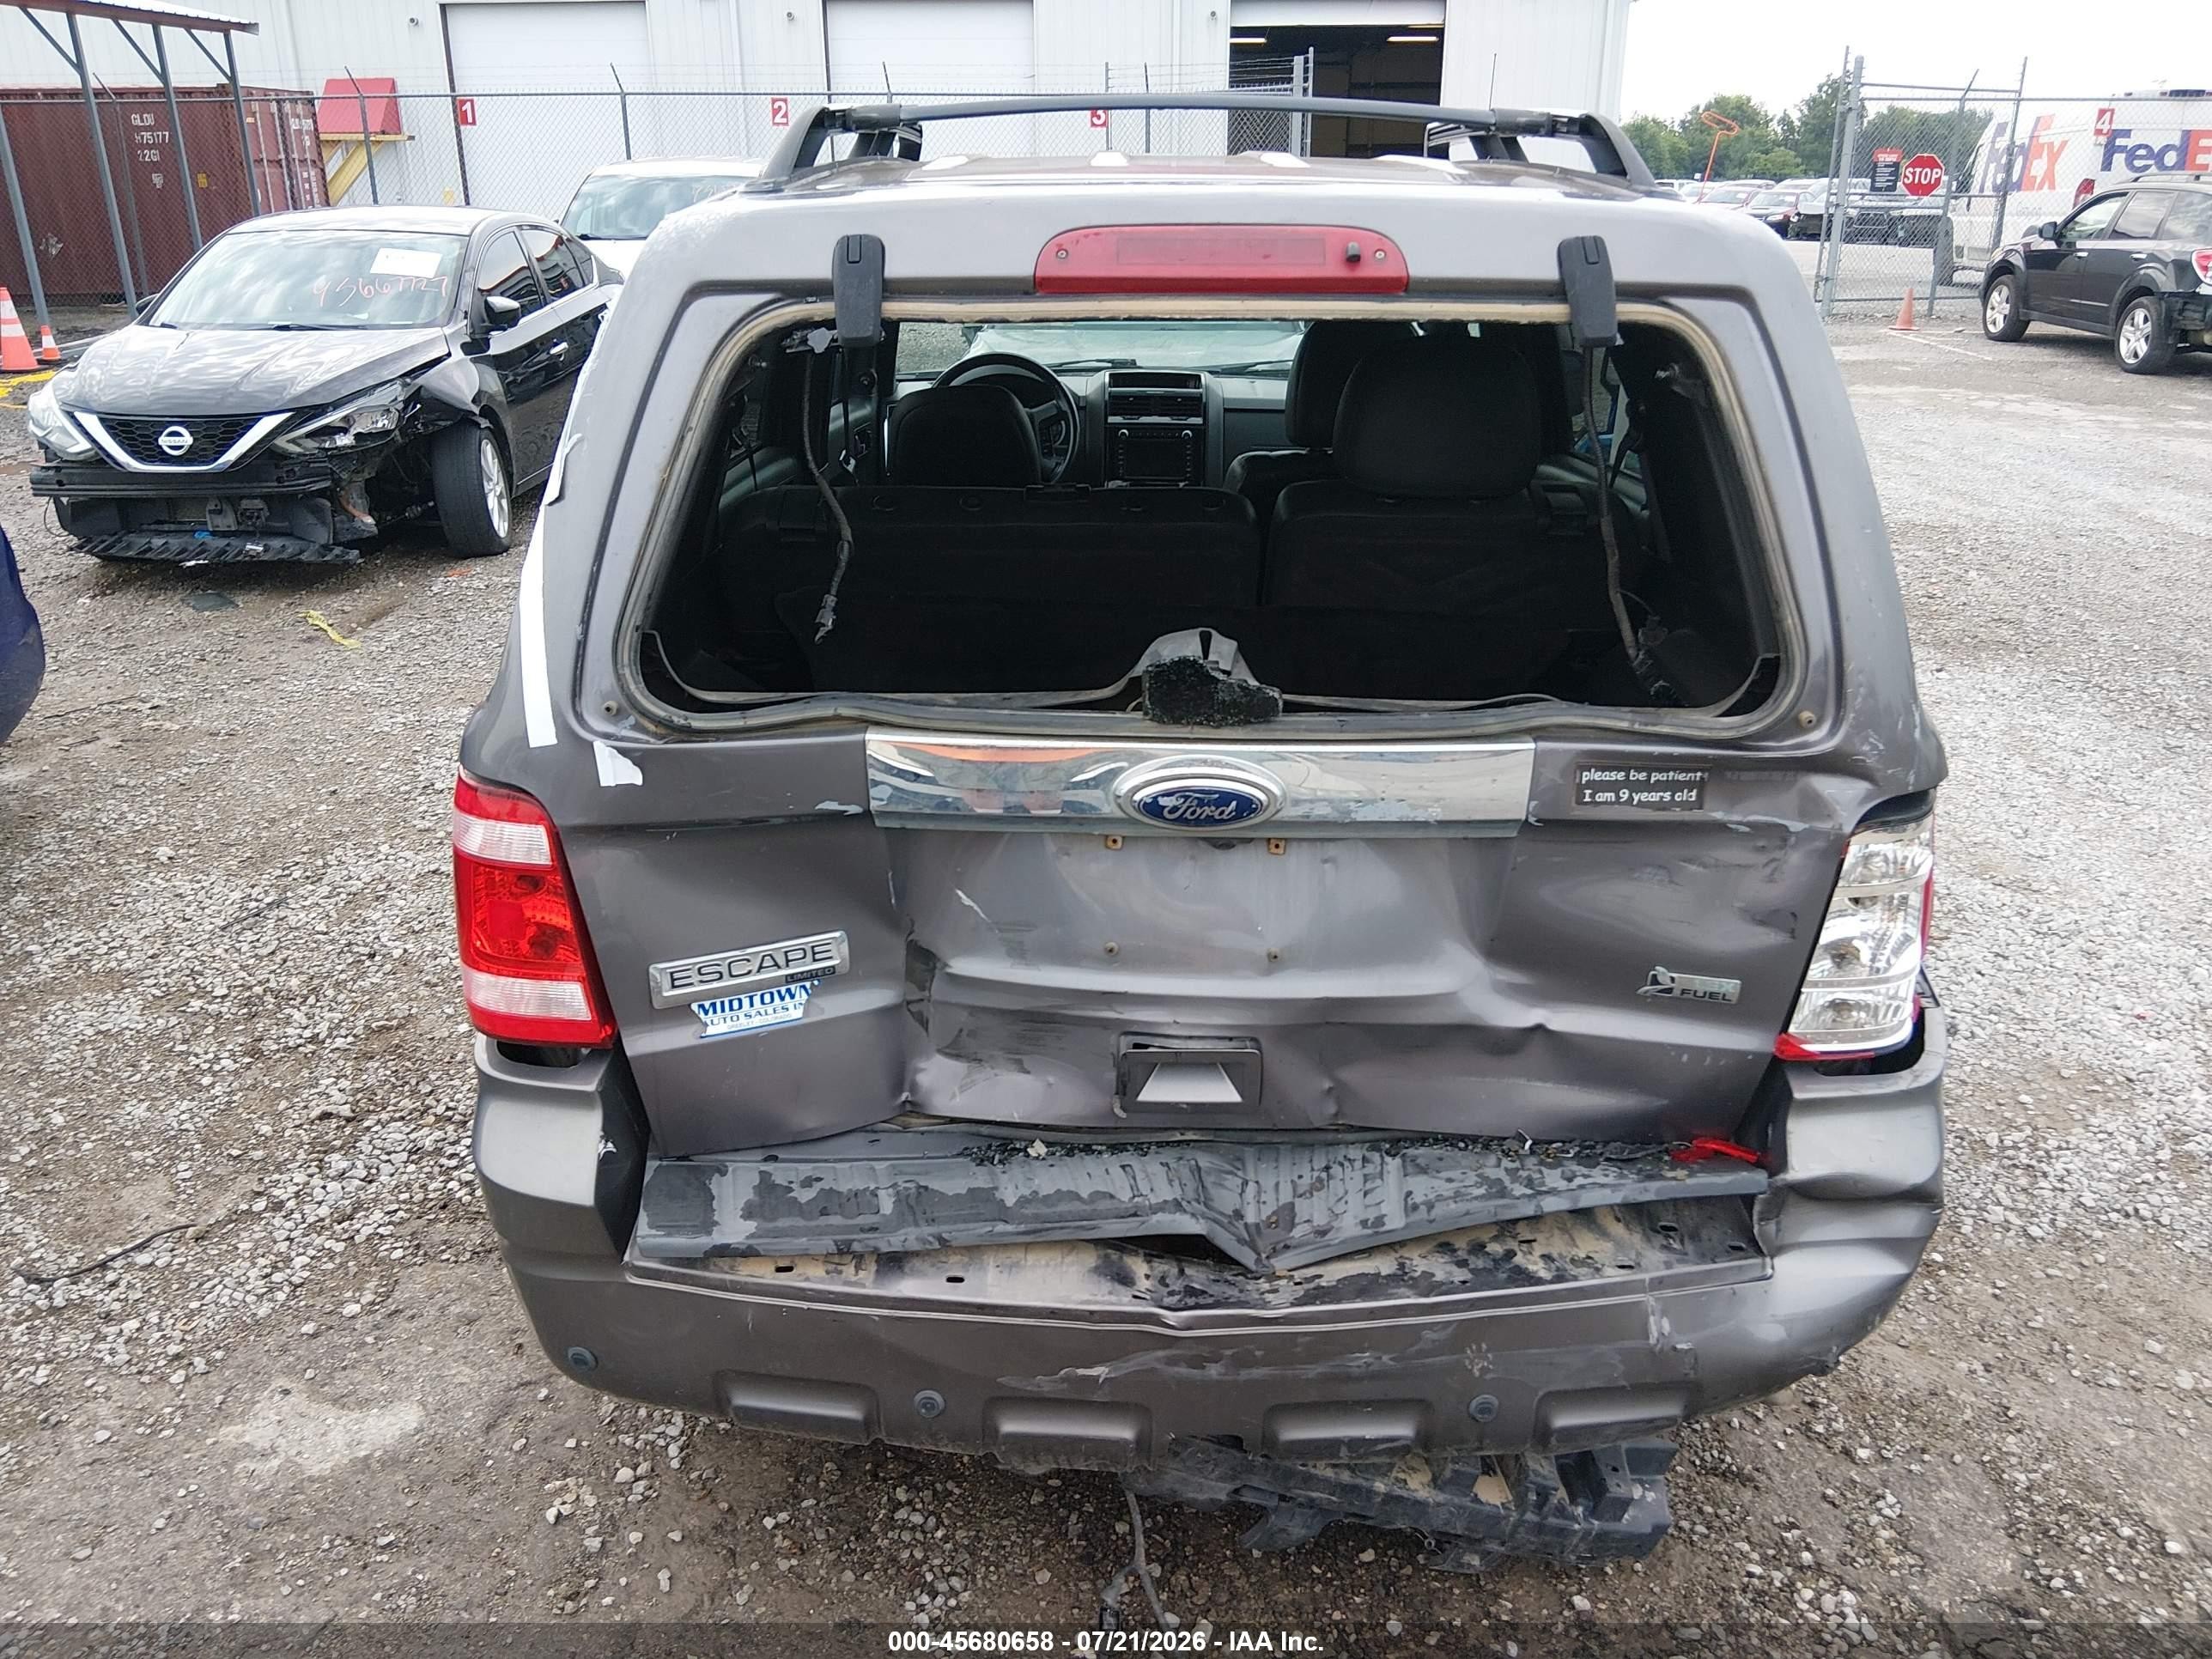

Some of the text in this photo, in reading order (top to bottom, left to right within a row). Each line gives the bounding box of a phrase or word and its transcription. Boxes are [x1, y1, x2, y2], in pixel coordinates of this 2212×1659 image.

[461, 100, 473, 124] 1
[773, 100, 787, 124] 2
[2095, 110, 2112, 135] 4
[1978, 113, 2069, 194] FedEx
[2100, 129, 2212, 173] FedE
[1904, 167, 1942, 185] STOP
[1581, 768, 1626, 784] please
[1629, 769, 1651, 781] be
[1158, 792, 1237, 821] Ford
[1583, 788, 1698, 805] I am 9 years old
[669, 941, 835, 989] ESCAPE
[787, 966, 835, 982] LIMITED
[696, 982, 812, 1017] MIDTOWN
[1680, 988, 1733, 1002] FUEL
[744, 1004, 790, 1020] SALES
